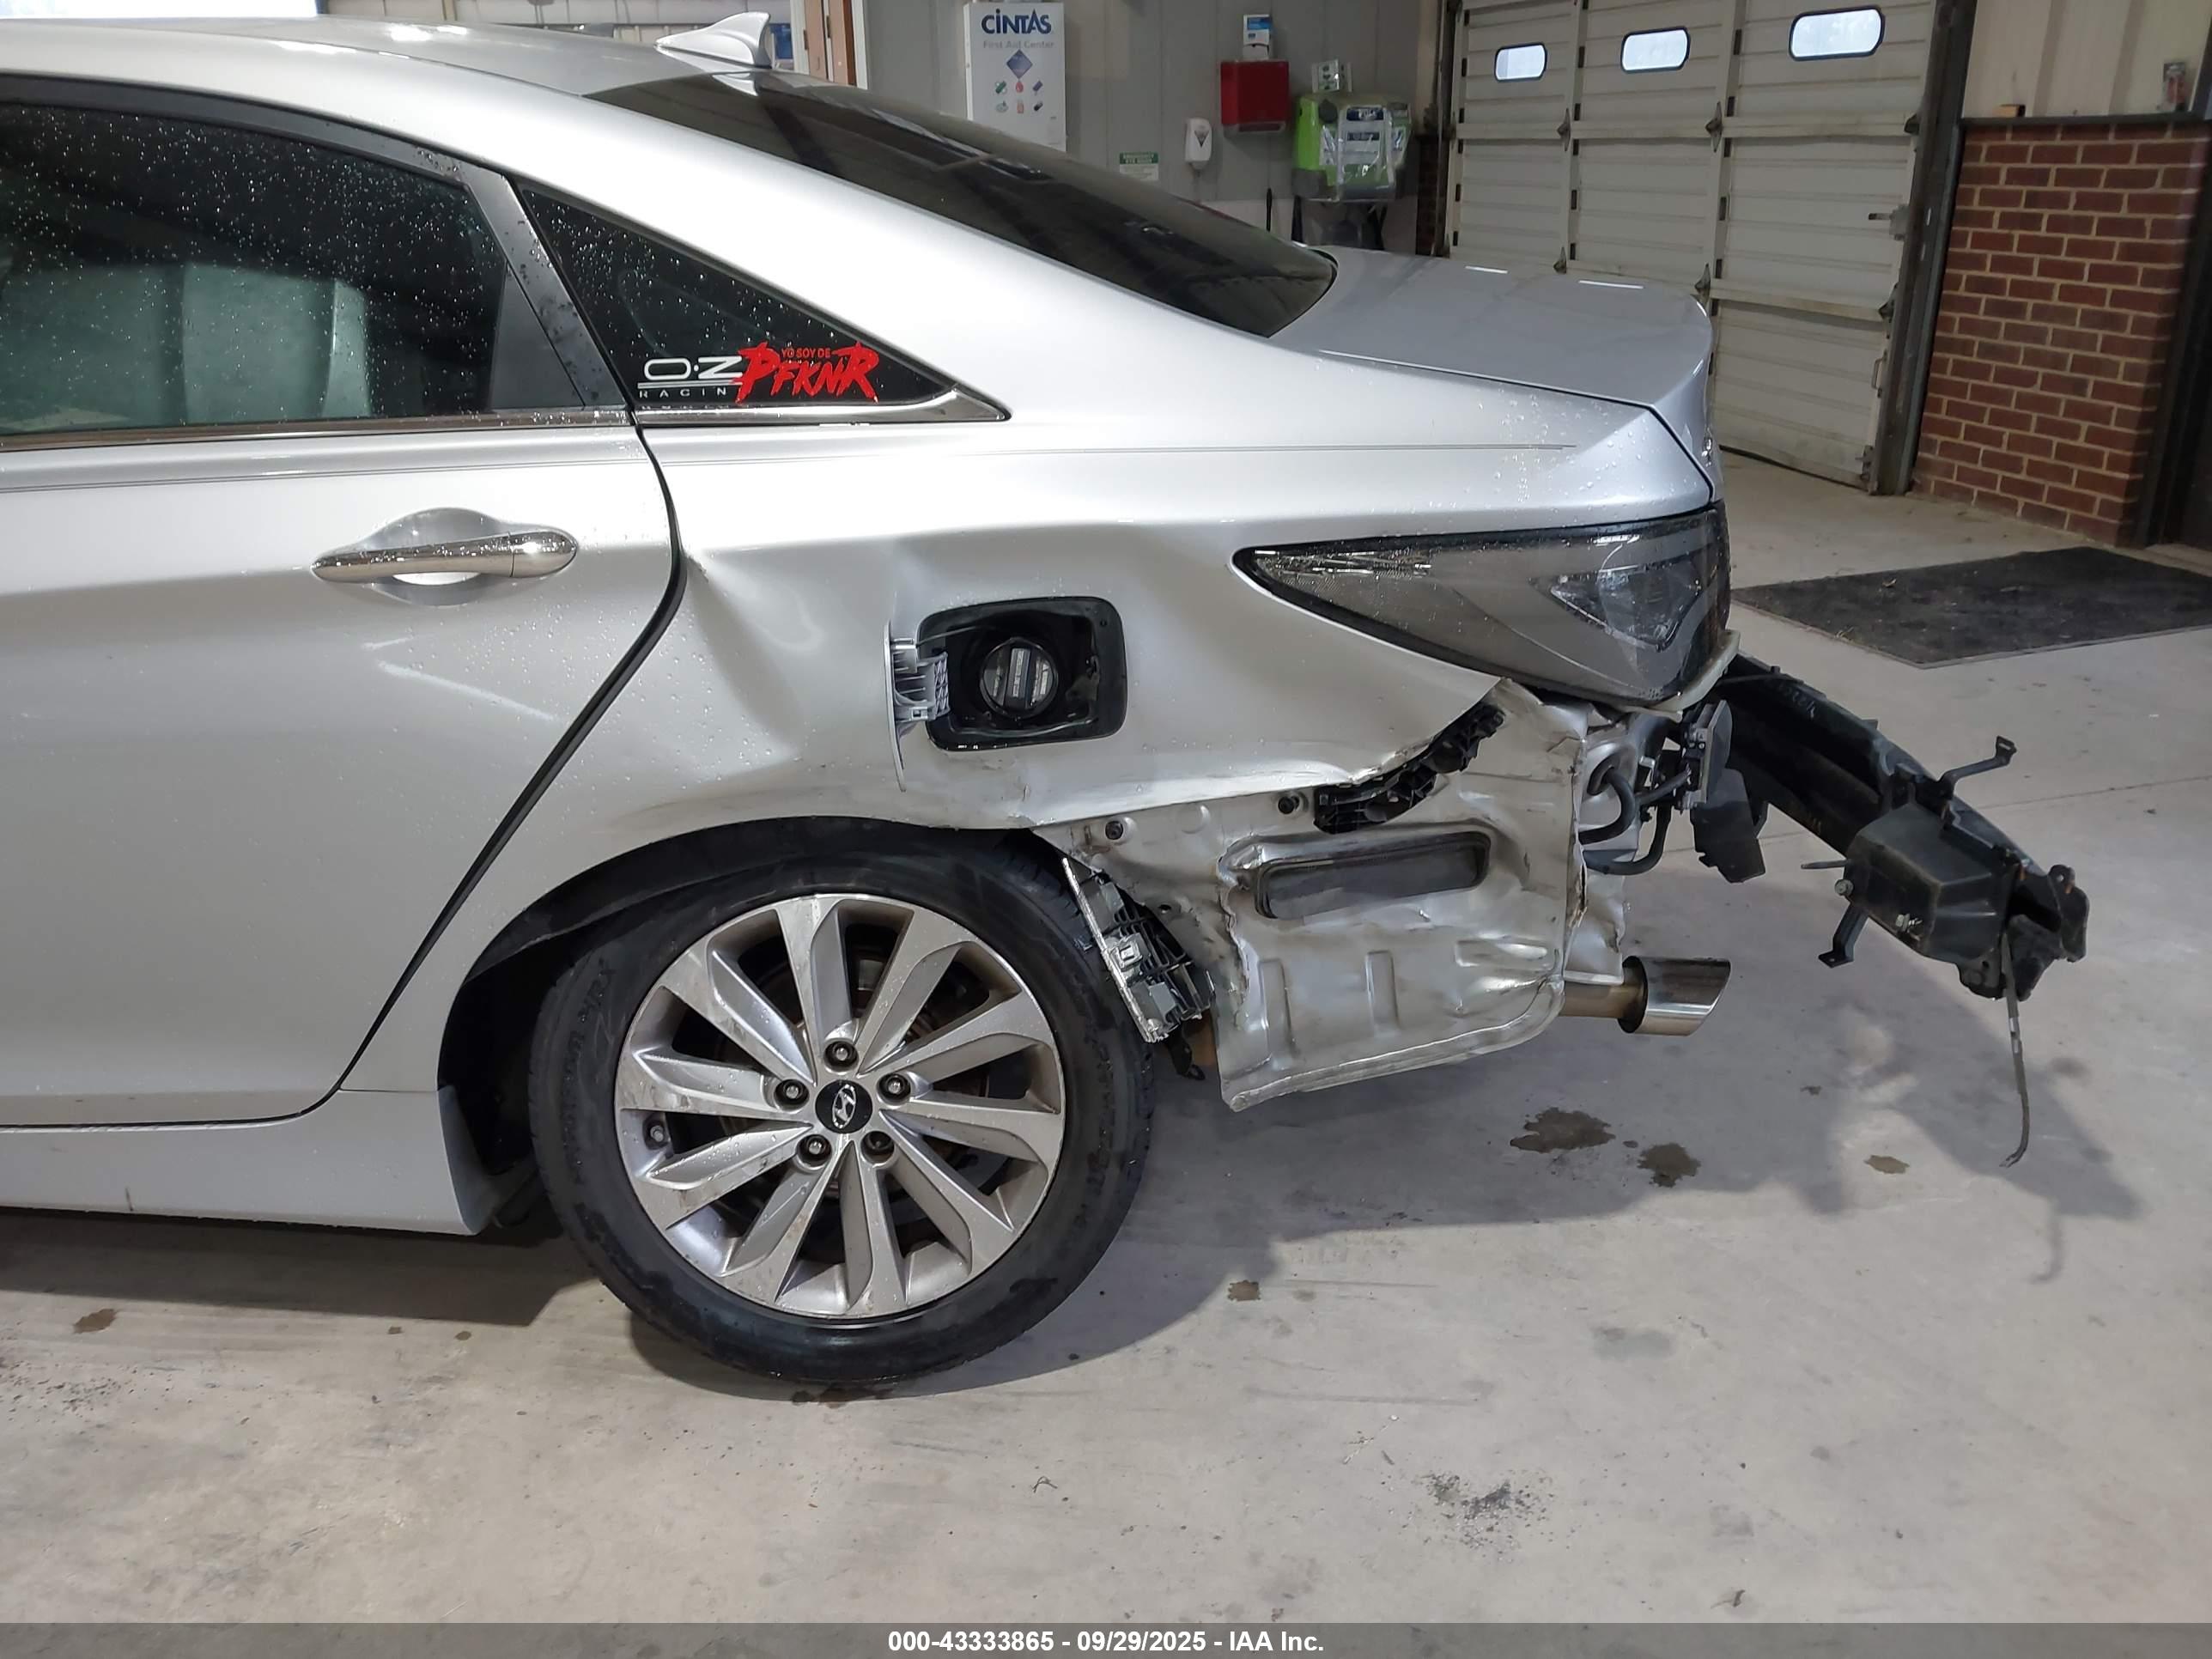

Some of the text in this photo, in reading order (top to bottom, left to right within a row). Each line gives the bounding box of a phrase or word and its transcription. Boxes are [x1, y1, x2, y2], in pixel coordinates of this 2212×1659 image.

[981, 9, 1052, 34] CINTAS
[983, 40, 1054, 49] First Aid Center
[781, 348, 831, 358] YO SOY DE
[639, 387, 727, 398] RACIN
